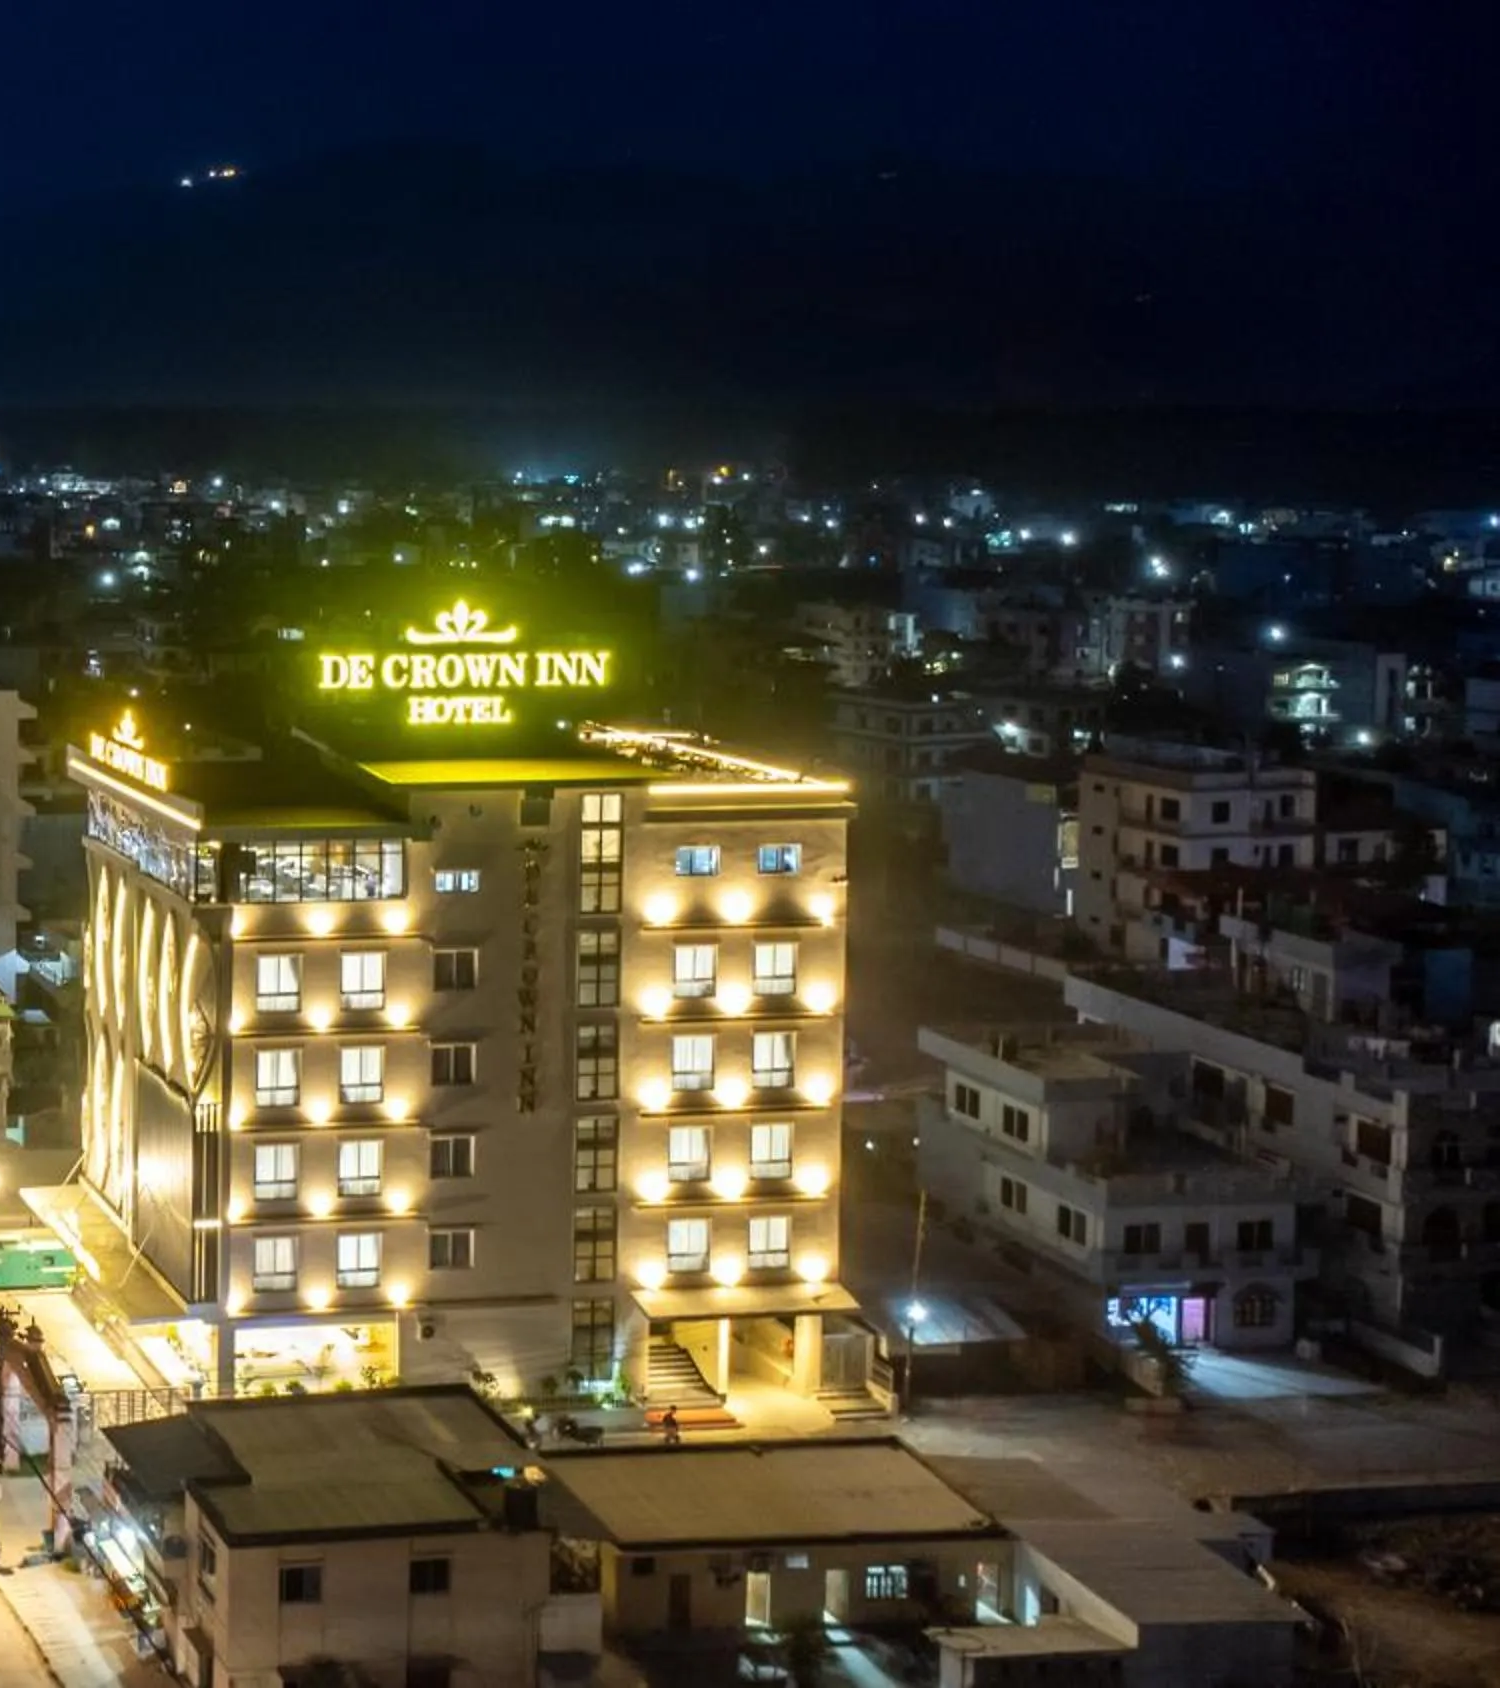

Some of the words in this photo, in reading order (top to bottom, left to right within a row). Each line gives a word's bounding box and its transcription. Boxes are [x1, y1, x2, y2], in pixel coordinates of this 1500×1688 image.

[320, 654, 374, 689] DE
[382, 653, 527, 689] CROWN
[535, 651, 609, 687] INN
[408, 696, 511, 725] HOTEL
